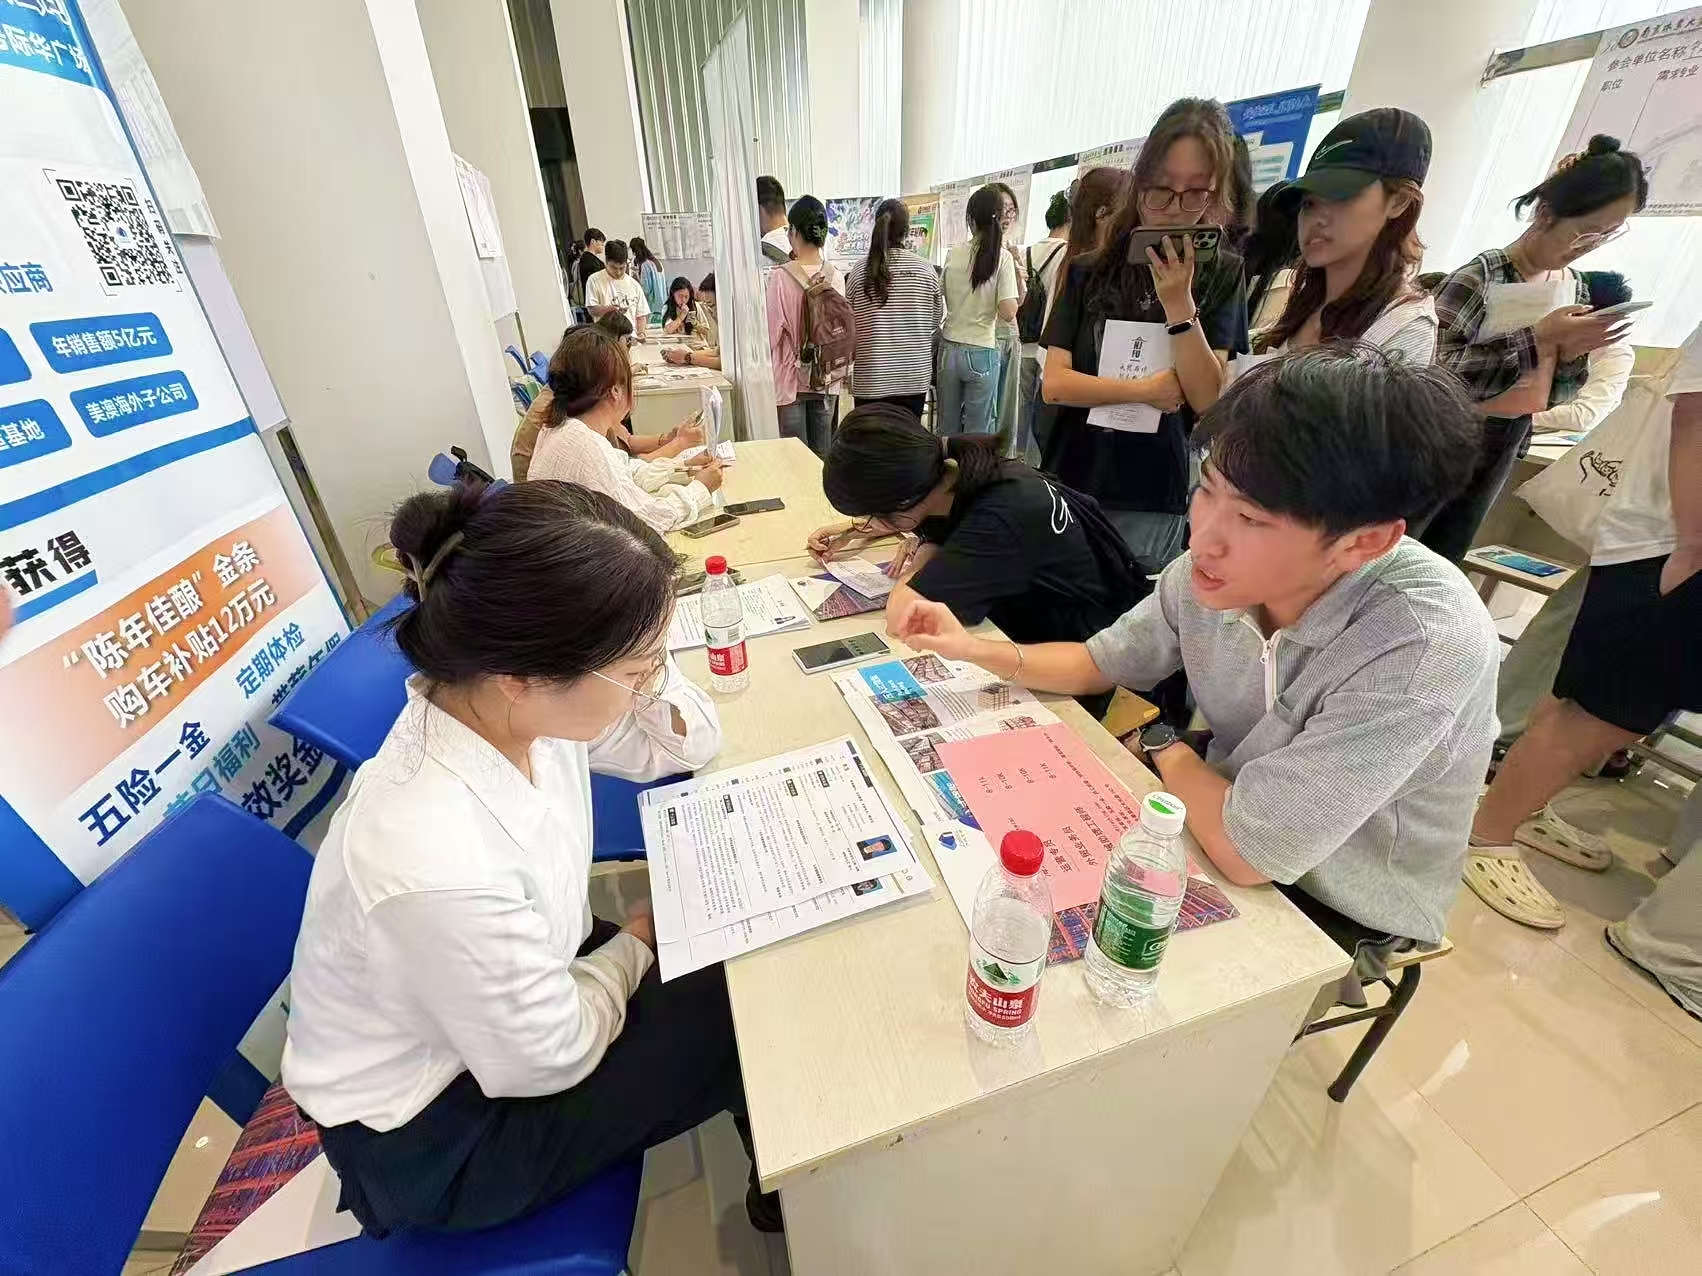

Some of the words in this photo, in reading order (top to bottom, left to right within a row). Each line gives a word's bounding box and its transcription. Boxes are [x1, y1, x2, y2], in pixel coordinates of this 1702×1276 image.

[1600, 79, 1623, 92] 职位
[0, 262, 53, 293] 应商
[52, 326, 157, 358] 年销售额5亿元
[85, 383, 188, 425] 美澳海外子公司
[0, 530, 92, 596] 获得
[235, 622, 306, 699] 定期体检
[78, 721, 211, 846] 五险一金
[1042, 839, 1073, 873] 运营专员
